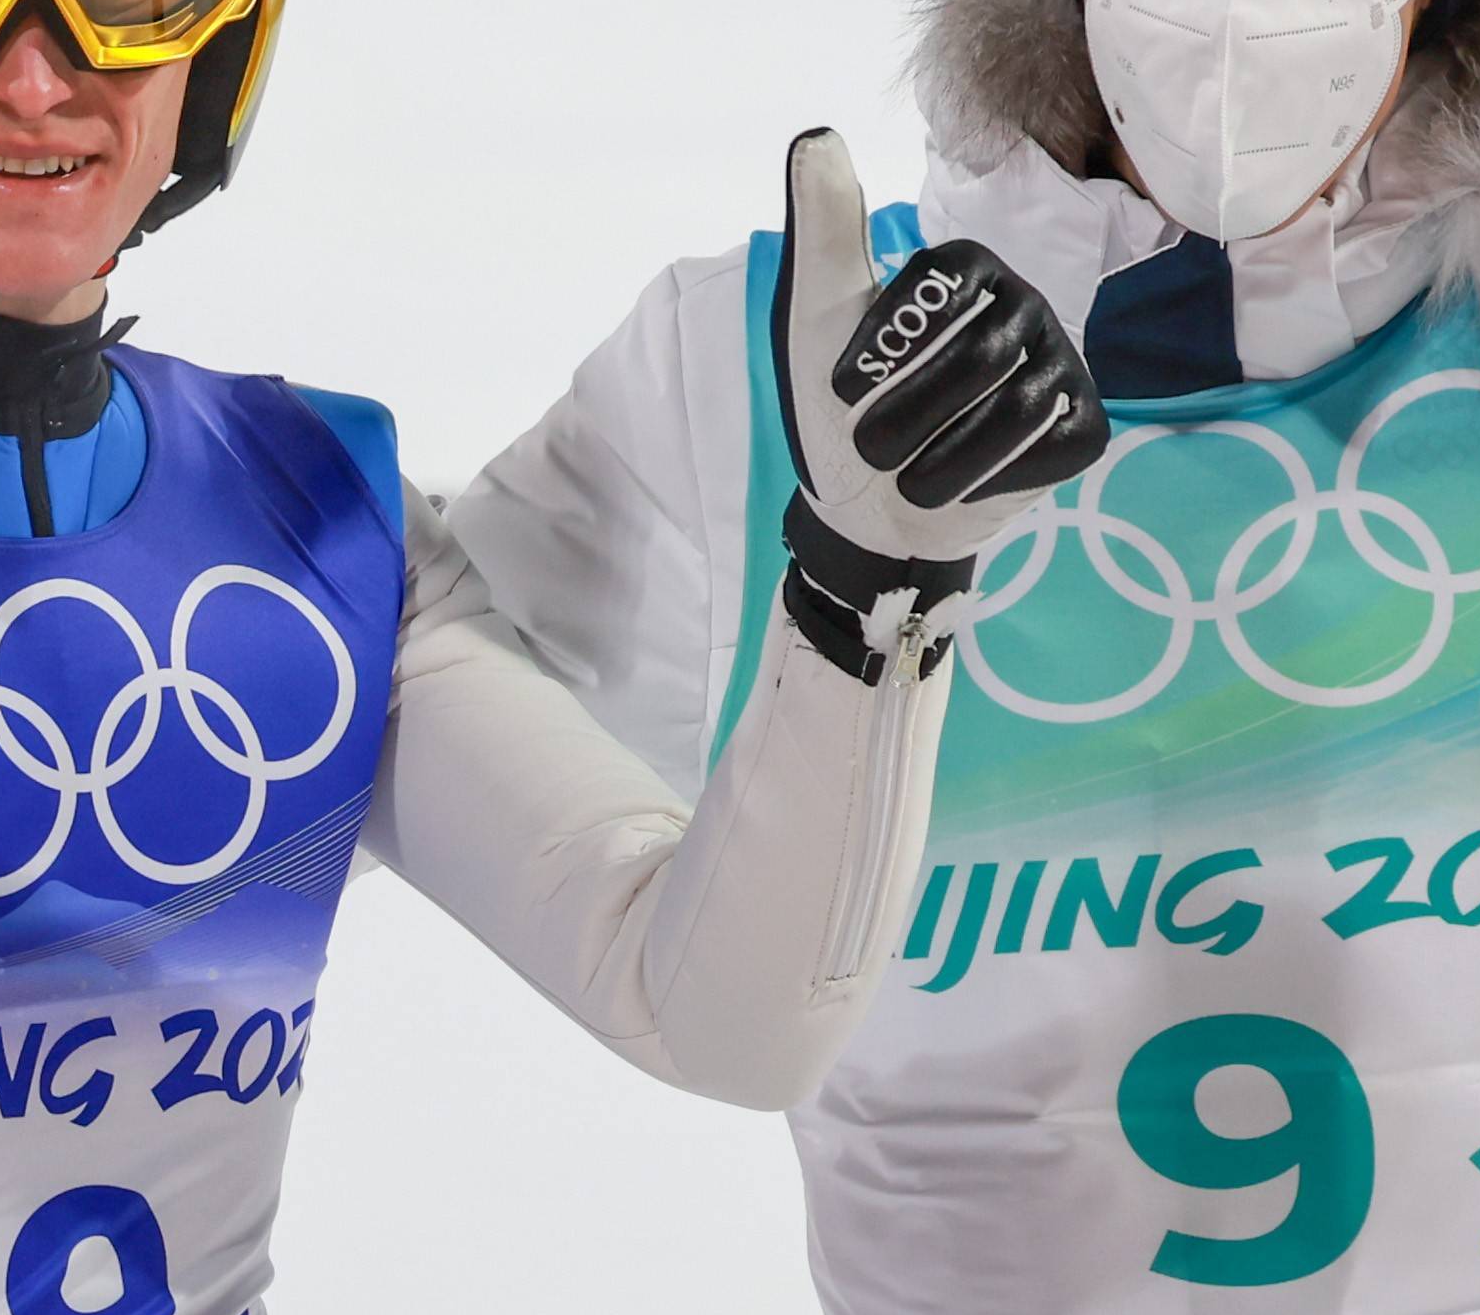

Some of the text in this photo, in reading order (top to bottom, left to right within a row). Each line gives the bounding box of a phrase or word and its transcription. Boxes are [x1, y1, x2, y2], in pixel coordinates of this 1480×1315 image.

[856, 266, 964, 384] S.COOL
[902, 847, 1264, 994] IJING
[1117, 1013, 1375, 1287] 9
